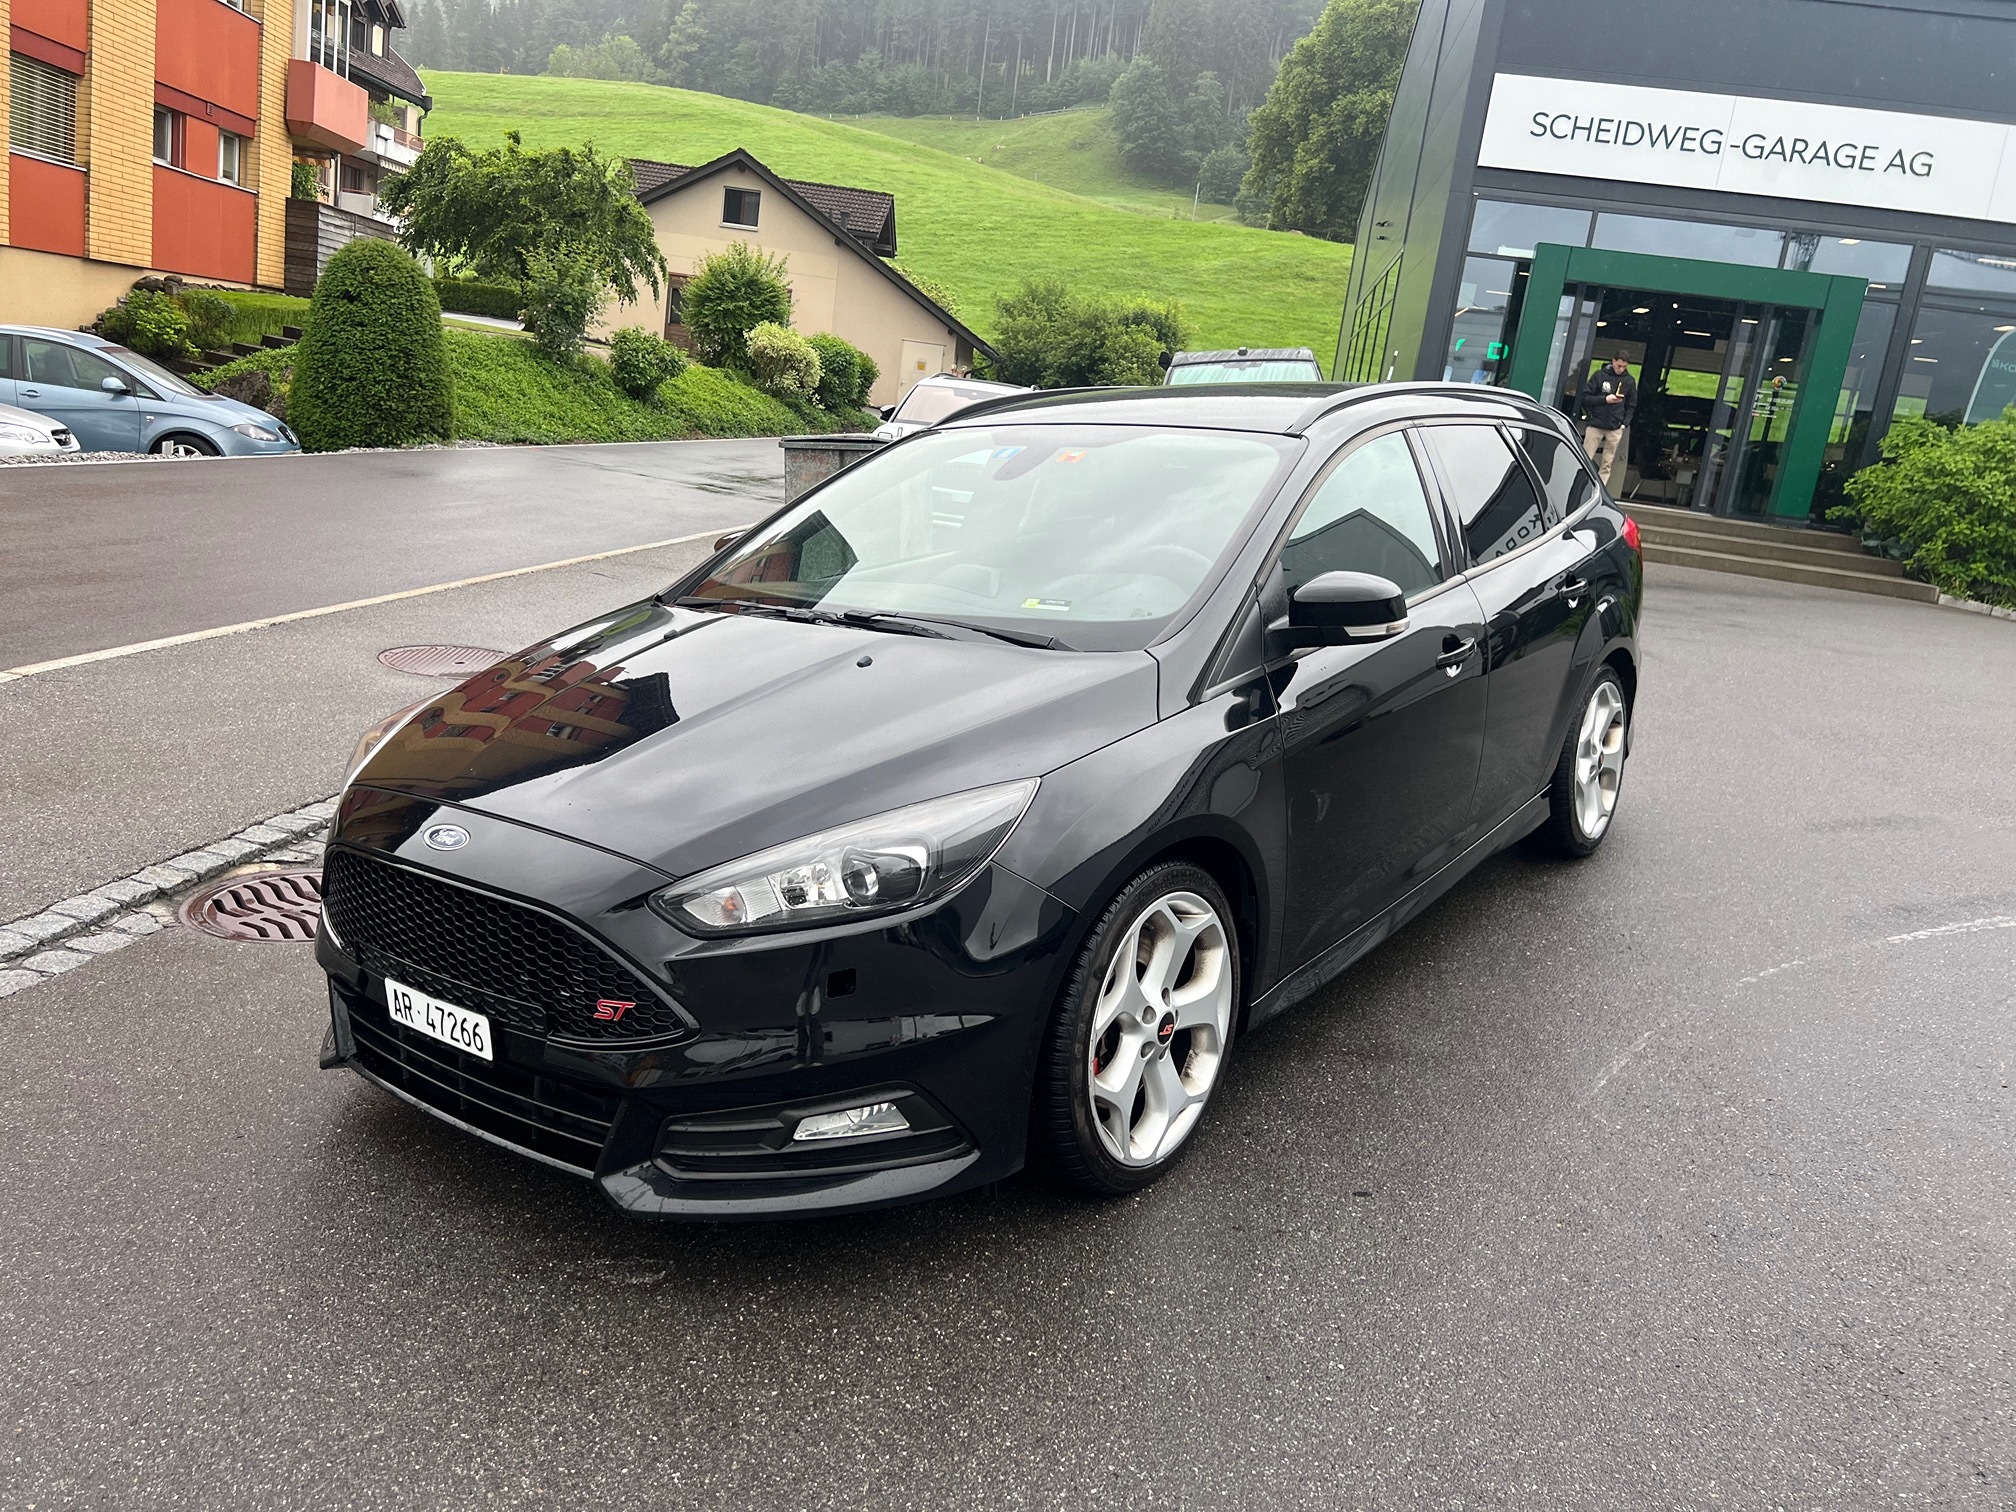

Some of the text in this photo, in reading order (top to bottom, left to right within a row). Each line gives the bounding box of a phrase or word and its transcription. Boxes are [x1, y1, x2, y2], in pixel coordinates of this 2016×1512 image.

[1529, 111, 1934, 178] SCHEIDWEG-GARAGE AG
[432, 828, 460, 846] Ford
[393, 988, 415, 1024] AR
[426, 1002, 484, 1053] 47266
[593, 999, 637, 1022] ST
